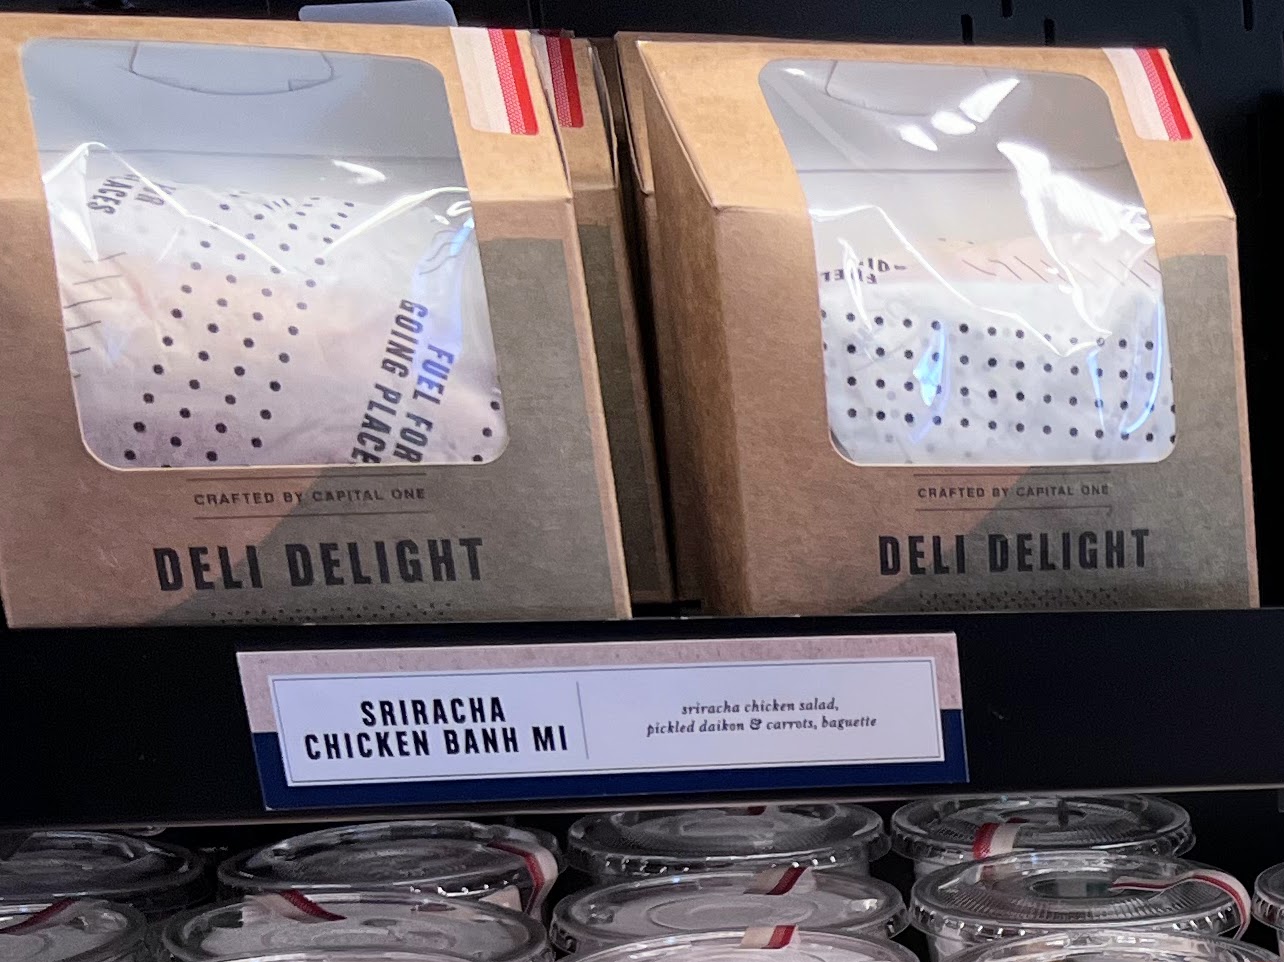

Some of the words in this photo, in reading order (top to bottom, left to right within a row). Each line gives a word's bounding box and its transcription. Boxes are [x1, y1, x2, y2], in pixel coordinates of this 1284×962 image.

[381, 299, 428, 378] GOING
[412, 343, 455, 405] FUEL
[393, 412, 433, 463] FOR
[194, 492, 274, 506] CRAFTED
[283, 491, 305, 505] BY
[312, 488, 386, 504] CAPITAL
[391, 487, 427, 501] ONE
[918, 486, 986, 499] CRAFTED
[992, 486, 1009, 499] BY
[1016, 485, 1075, 498] CAPITAL
[1081, 484, 1110, 497] ONE
[153, 544, 261, 592] DELI
[287, 537, 484, 588] DELIGHT
[879, 533, 966, 576] DELI
[989, 528, 1150, 573] DELIGHT
[360, 696, 506, 728] SRIRACHA
[646, 718, 696, 736] pickled
[699, 716, 745, 733] daikon
[749, 718, 763, 731] &
[765, 715, 818, 732] carrots,
[821, 712, 878, 734] baguette
[681, 700, 740, 715] sriracha
[743, 698, 796, 714] chicken
[799, 697, 840, 713] salad,
[305, 728, 432, 761] CHICKEN
[443, 726, 520, 756] BANH
[534, 724, 569, 752] MI
